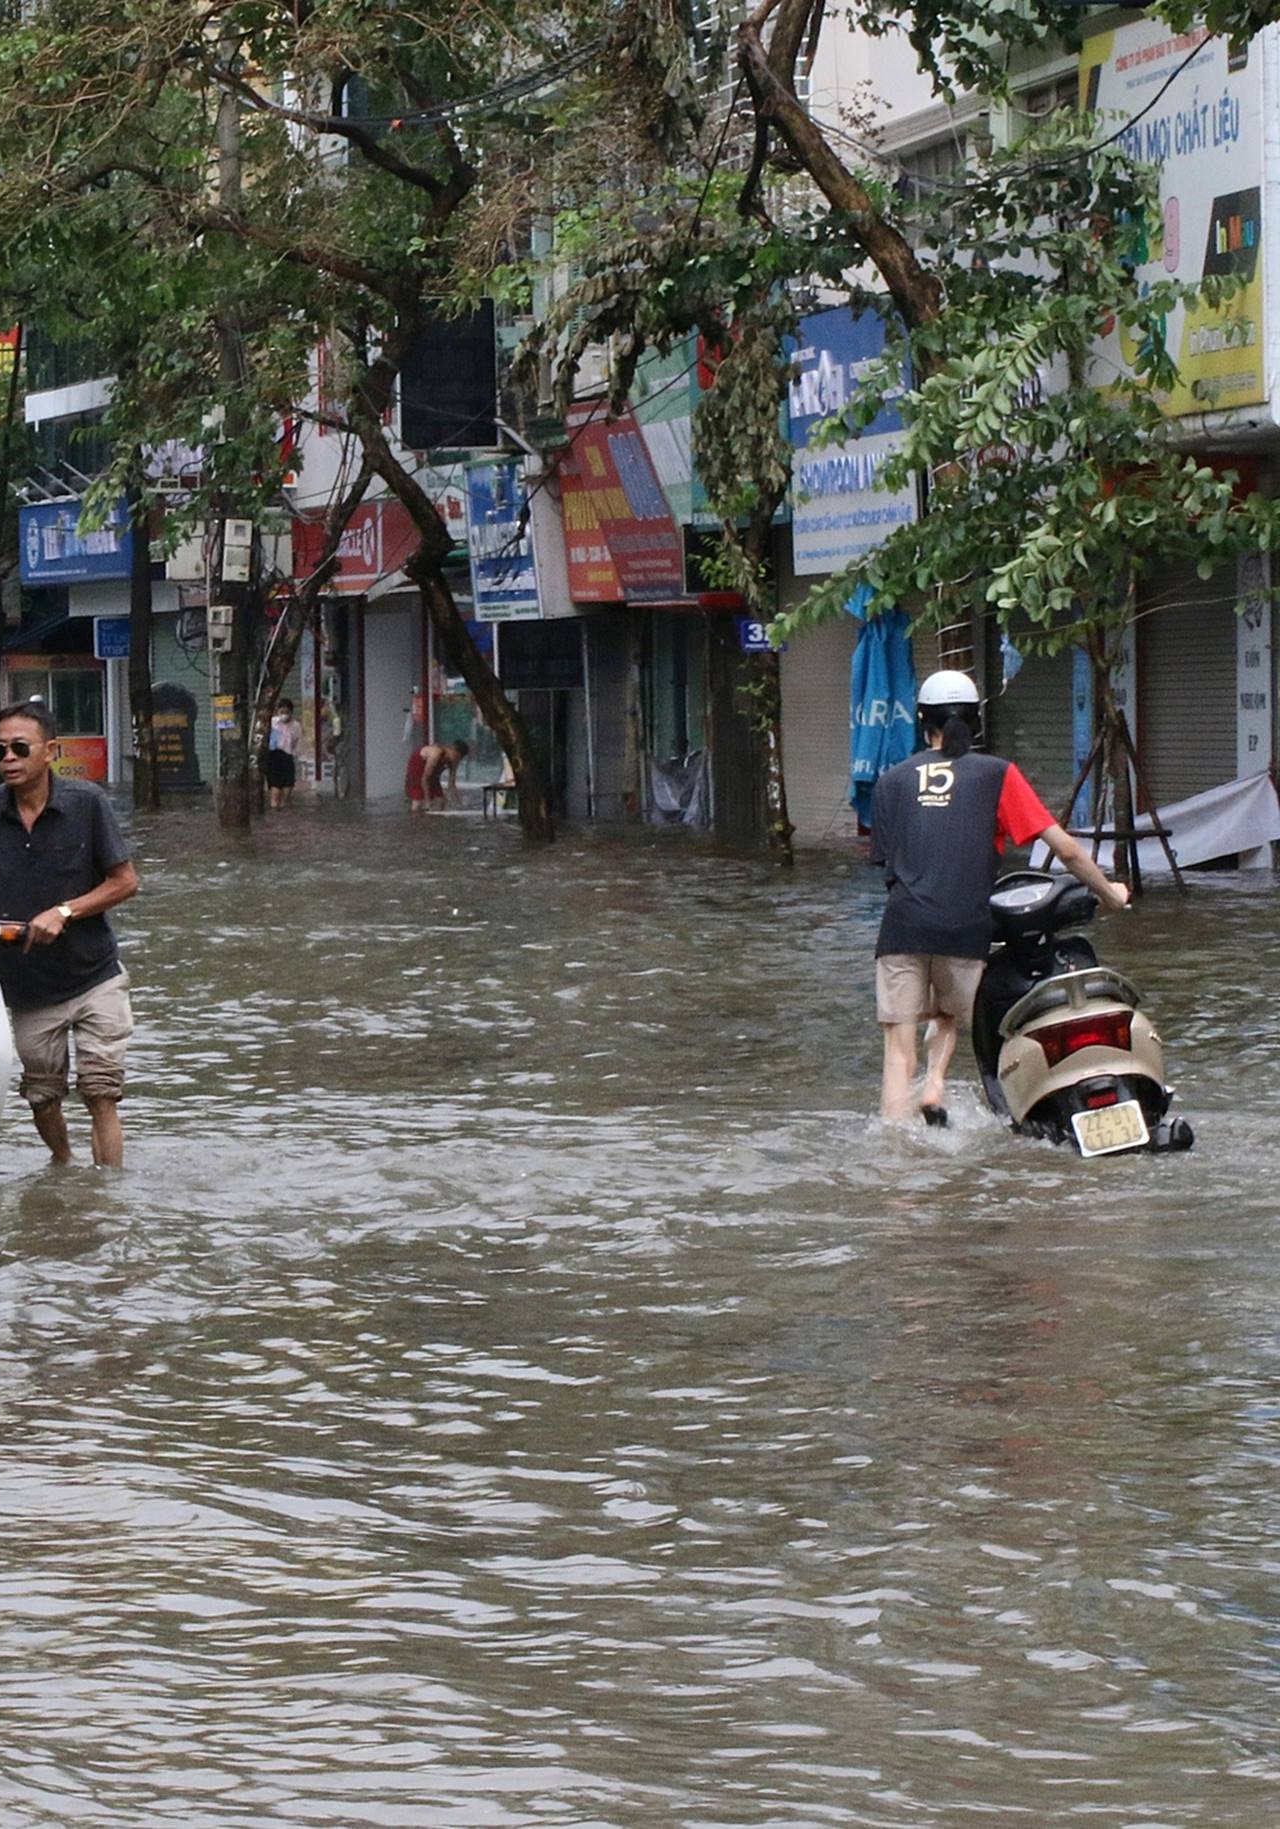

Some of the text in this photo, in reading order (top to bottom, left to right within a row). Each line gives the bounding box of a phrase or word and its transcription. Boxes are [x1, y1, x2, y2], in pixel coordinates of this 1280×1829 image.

[1174, 84, 1209, 155] CHẤT
[1212, 86, 1240, 153] LIỆU
[915, 761, 954, 793] 15
